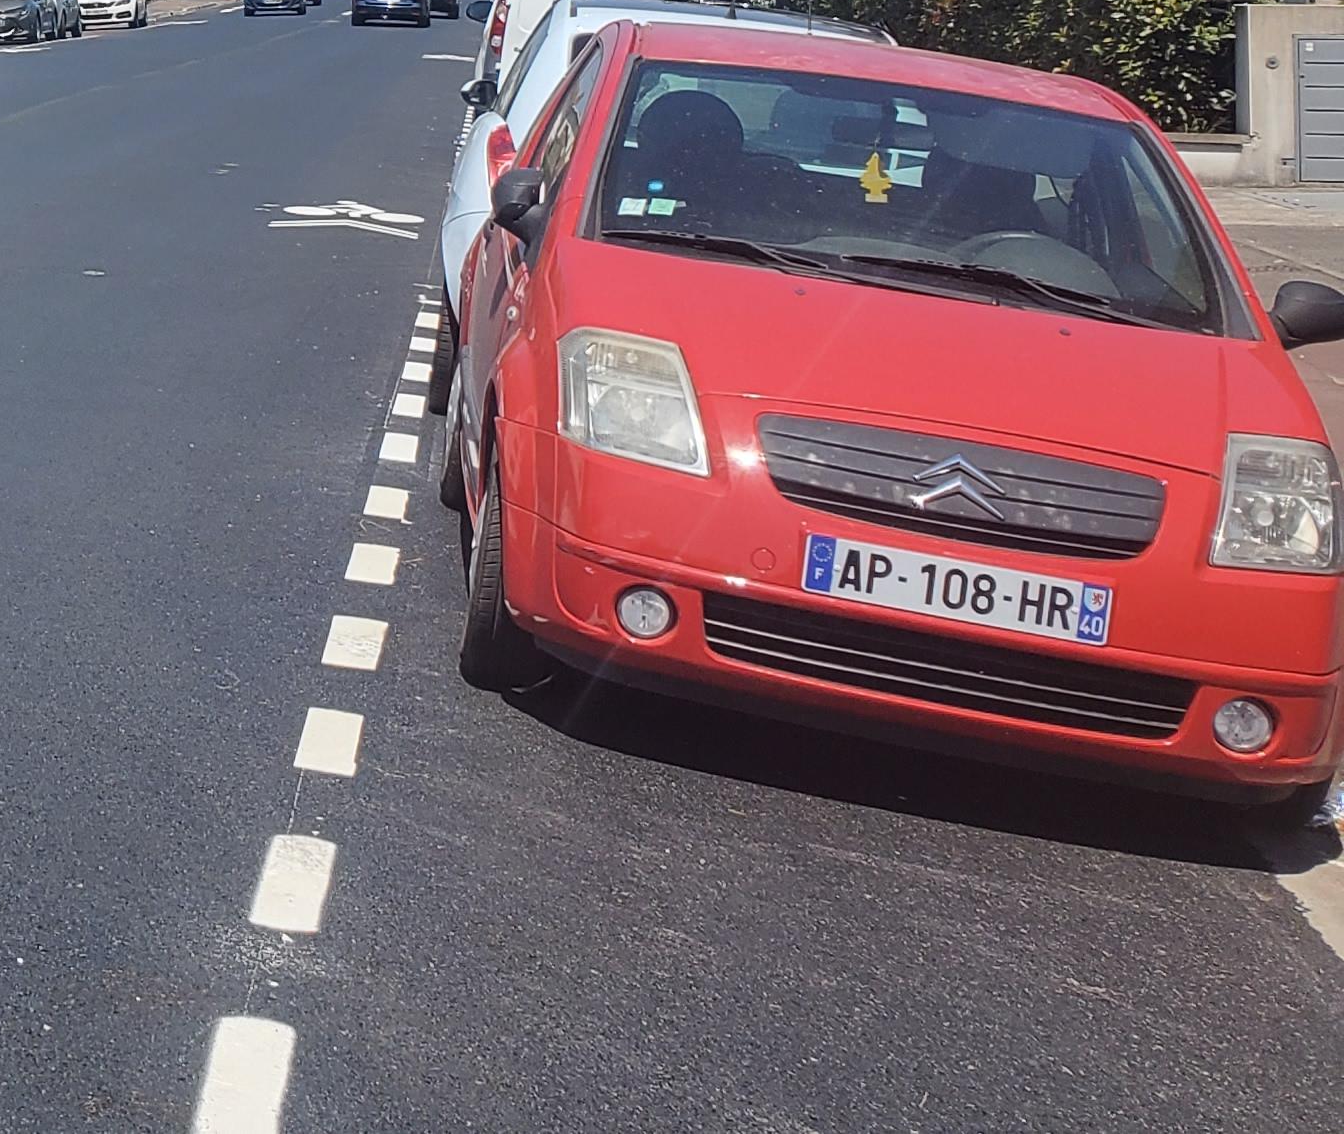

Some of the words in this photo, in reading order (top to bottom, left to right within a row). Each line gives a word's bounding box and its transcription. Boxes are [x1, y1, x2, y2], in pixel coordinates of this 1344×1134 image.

[813, 567, 825, 581] F
[838, 549, 1074, 631] AP-108-HR
[1078, 615, 1103, 637] 40
